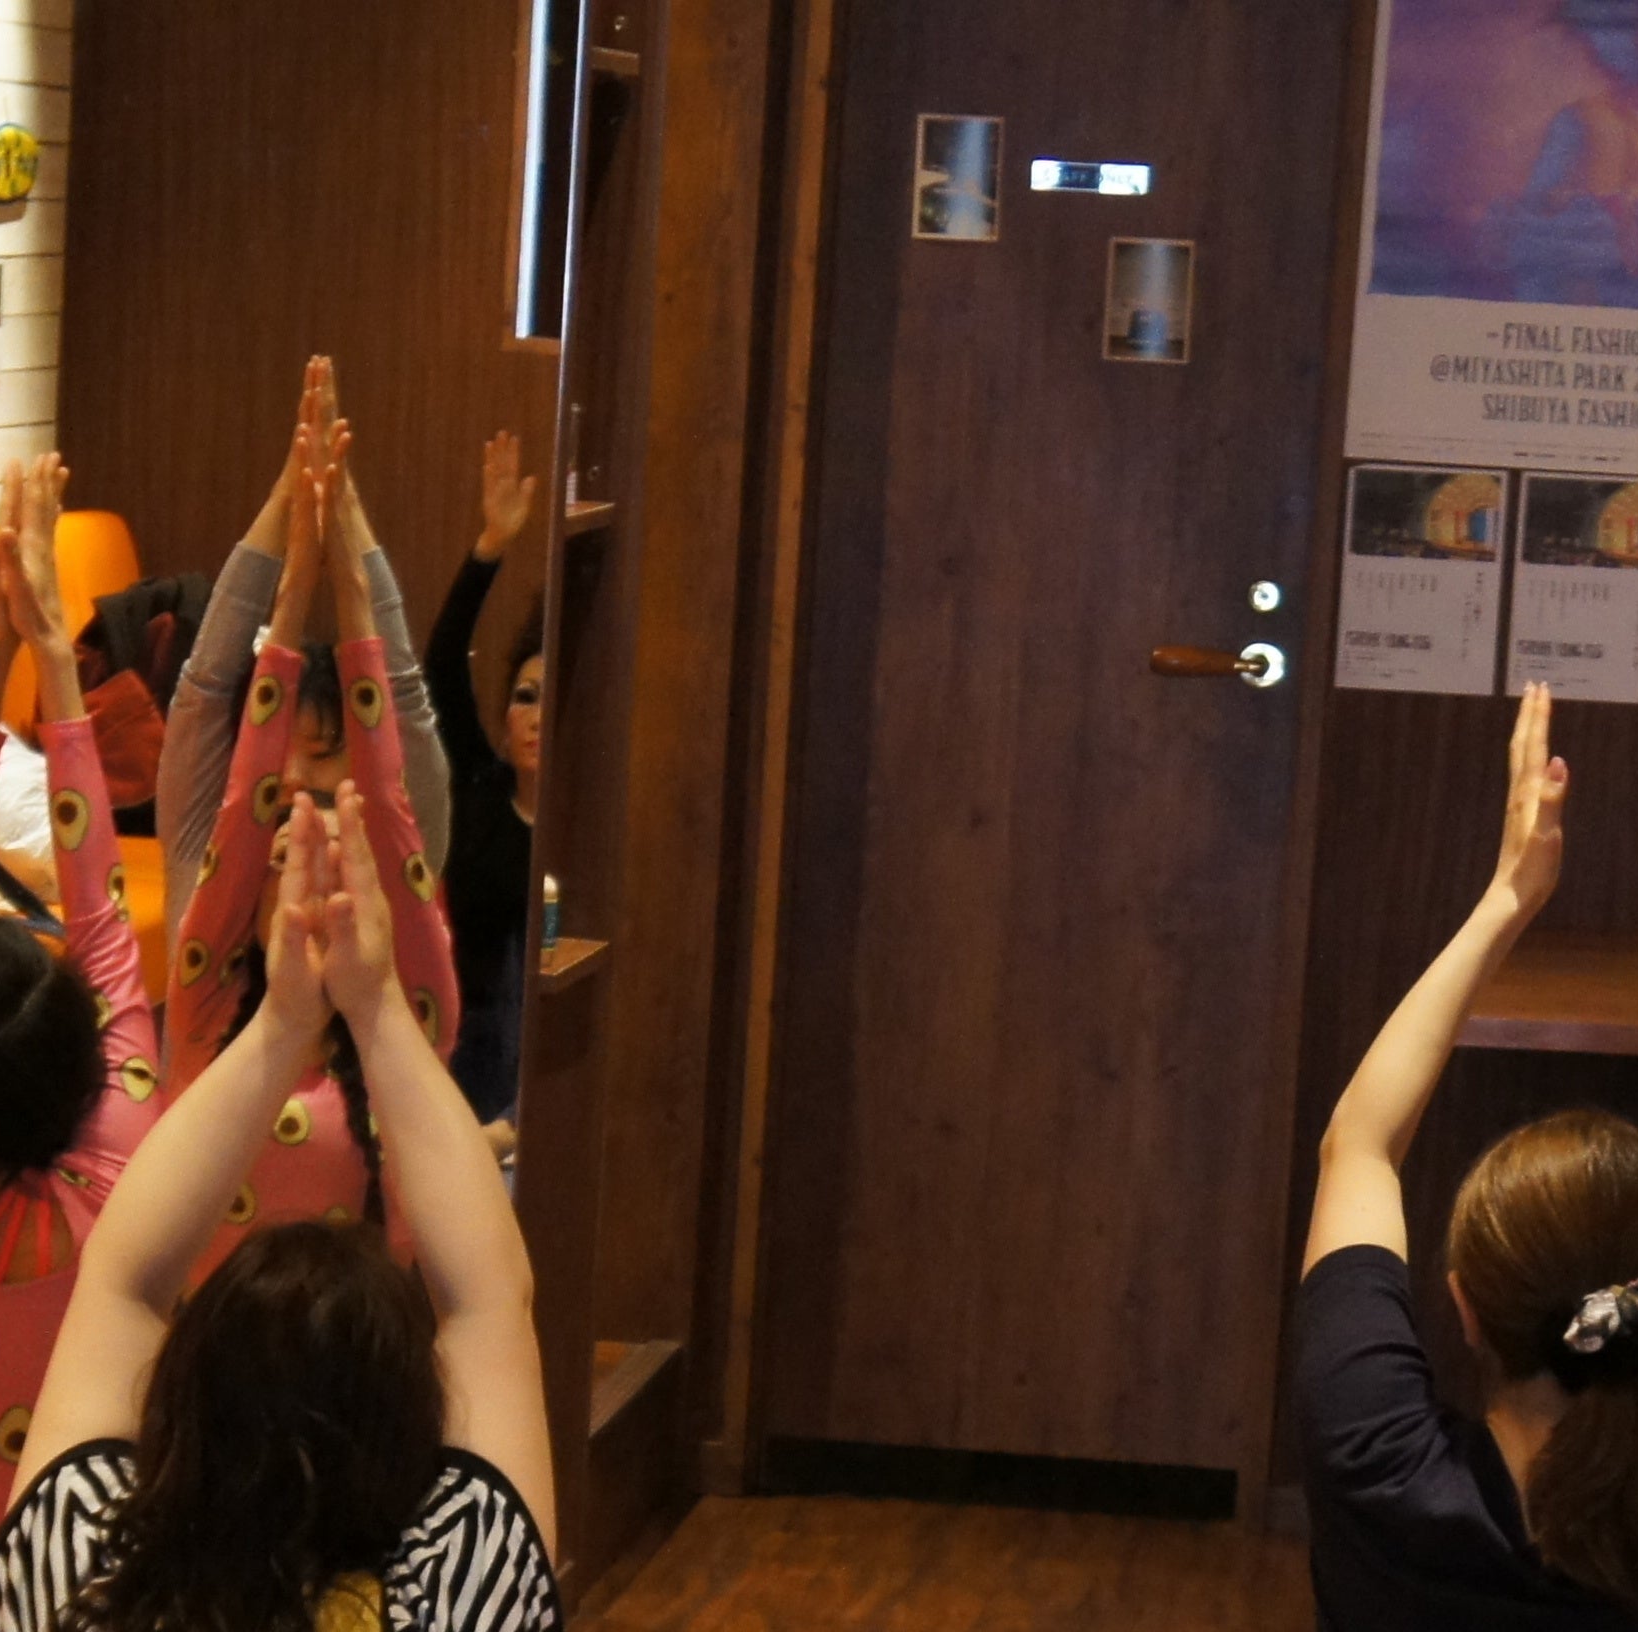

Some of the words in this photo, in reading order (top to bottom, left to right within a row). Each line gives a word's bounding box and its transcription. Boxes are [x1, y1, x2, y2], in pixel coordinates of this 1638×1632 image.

[1429, 353, 1567, 387] @MIYASHITA
[1571, 362, 1629, 392] PARK
[1481, 393, 1571, 425] SHIBUYA
